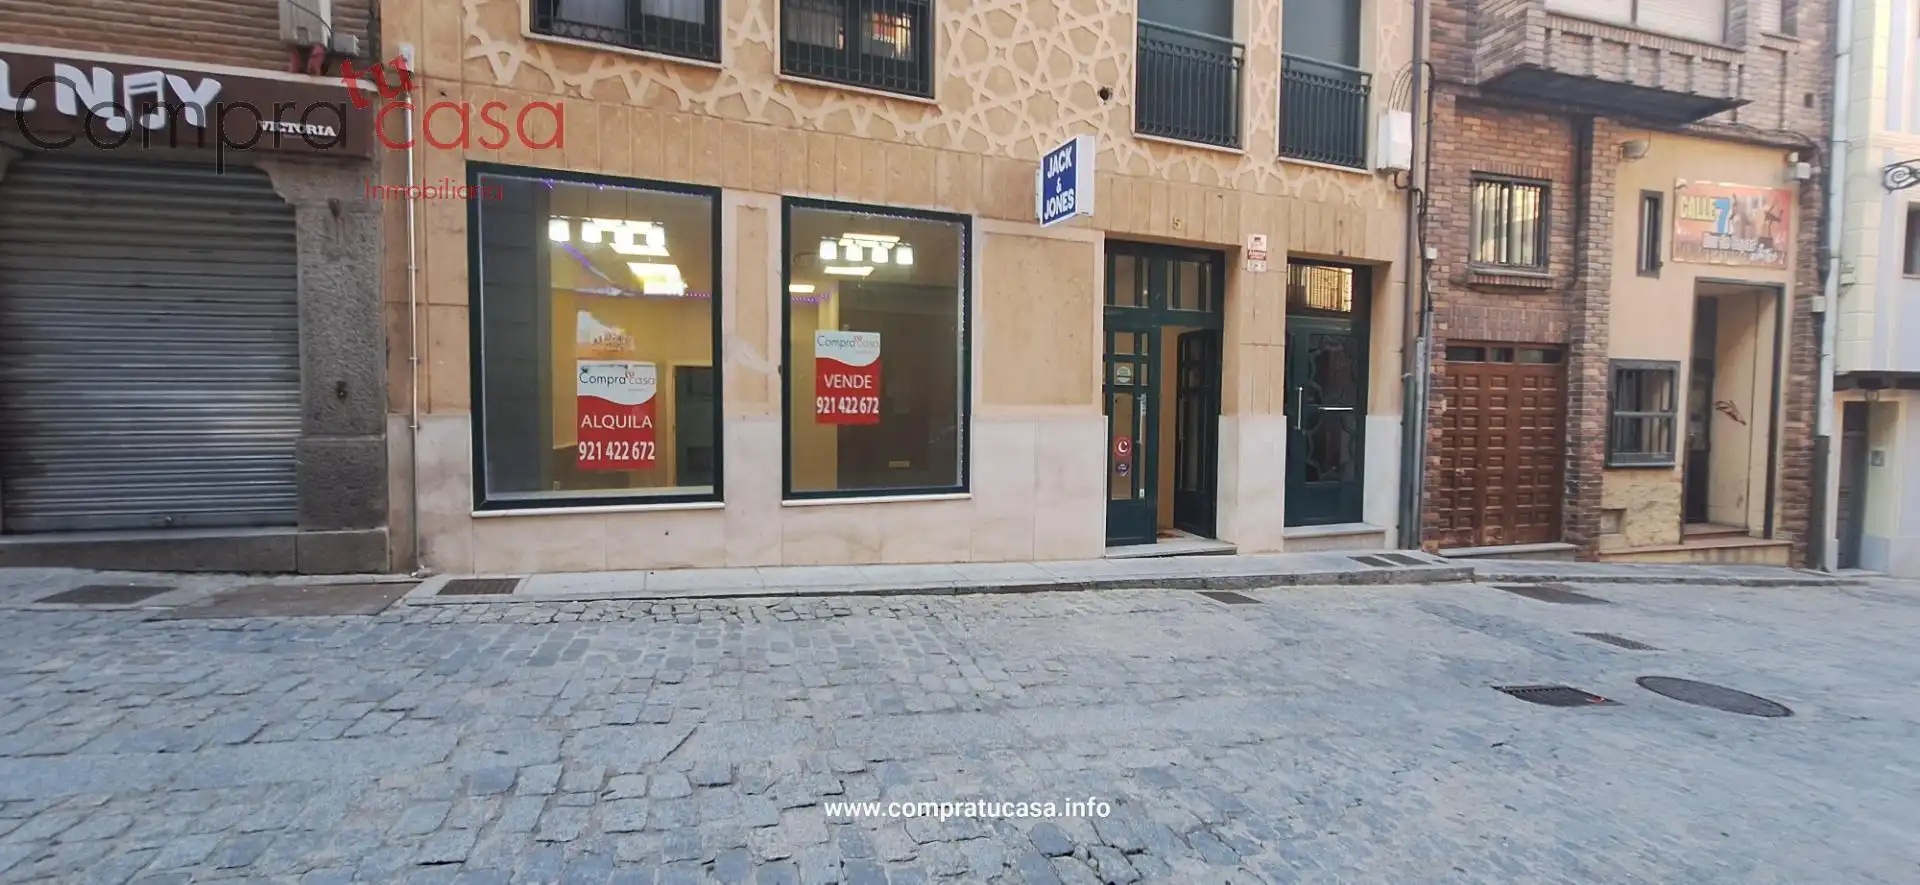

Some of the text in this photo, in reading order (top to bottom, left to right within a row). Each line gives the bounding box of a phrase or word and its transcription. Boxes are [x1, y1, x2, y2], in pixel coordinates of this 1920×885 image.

[258, 120, 337, 137] VICTORIA
[1047, 145, 1073, 179] JACK
[1056, 176, 1062, 194] &
[1044, 188, 1074, 220] JONES
[1681, 195, 1730, 234] CALLE 7
[817, 336, 856, 351] Compra
[579, 372, 626, 389] Compra
[629, 374, 656, 386] casa
[823, 374, 873, 389] VENDE
[816, 396, 880, 414] 921 422 672
[581, 414, 653, 430] ALQUILA
[579, 441, 656, 461] 921 422 672
